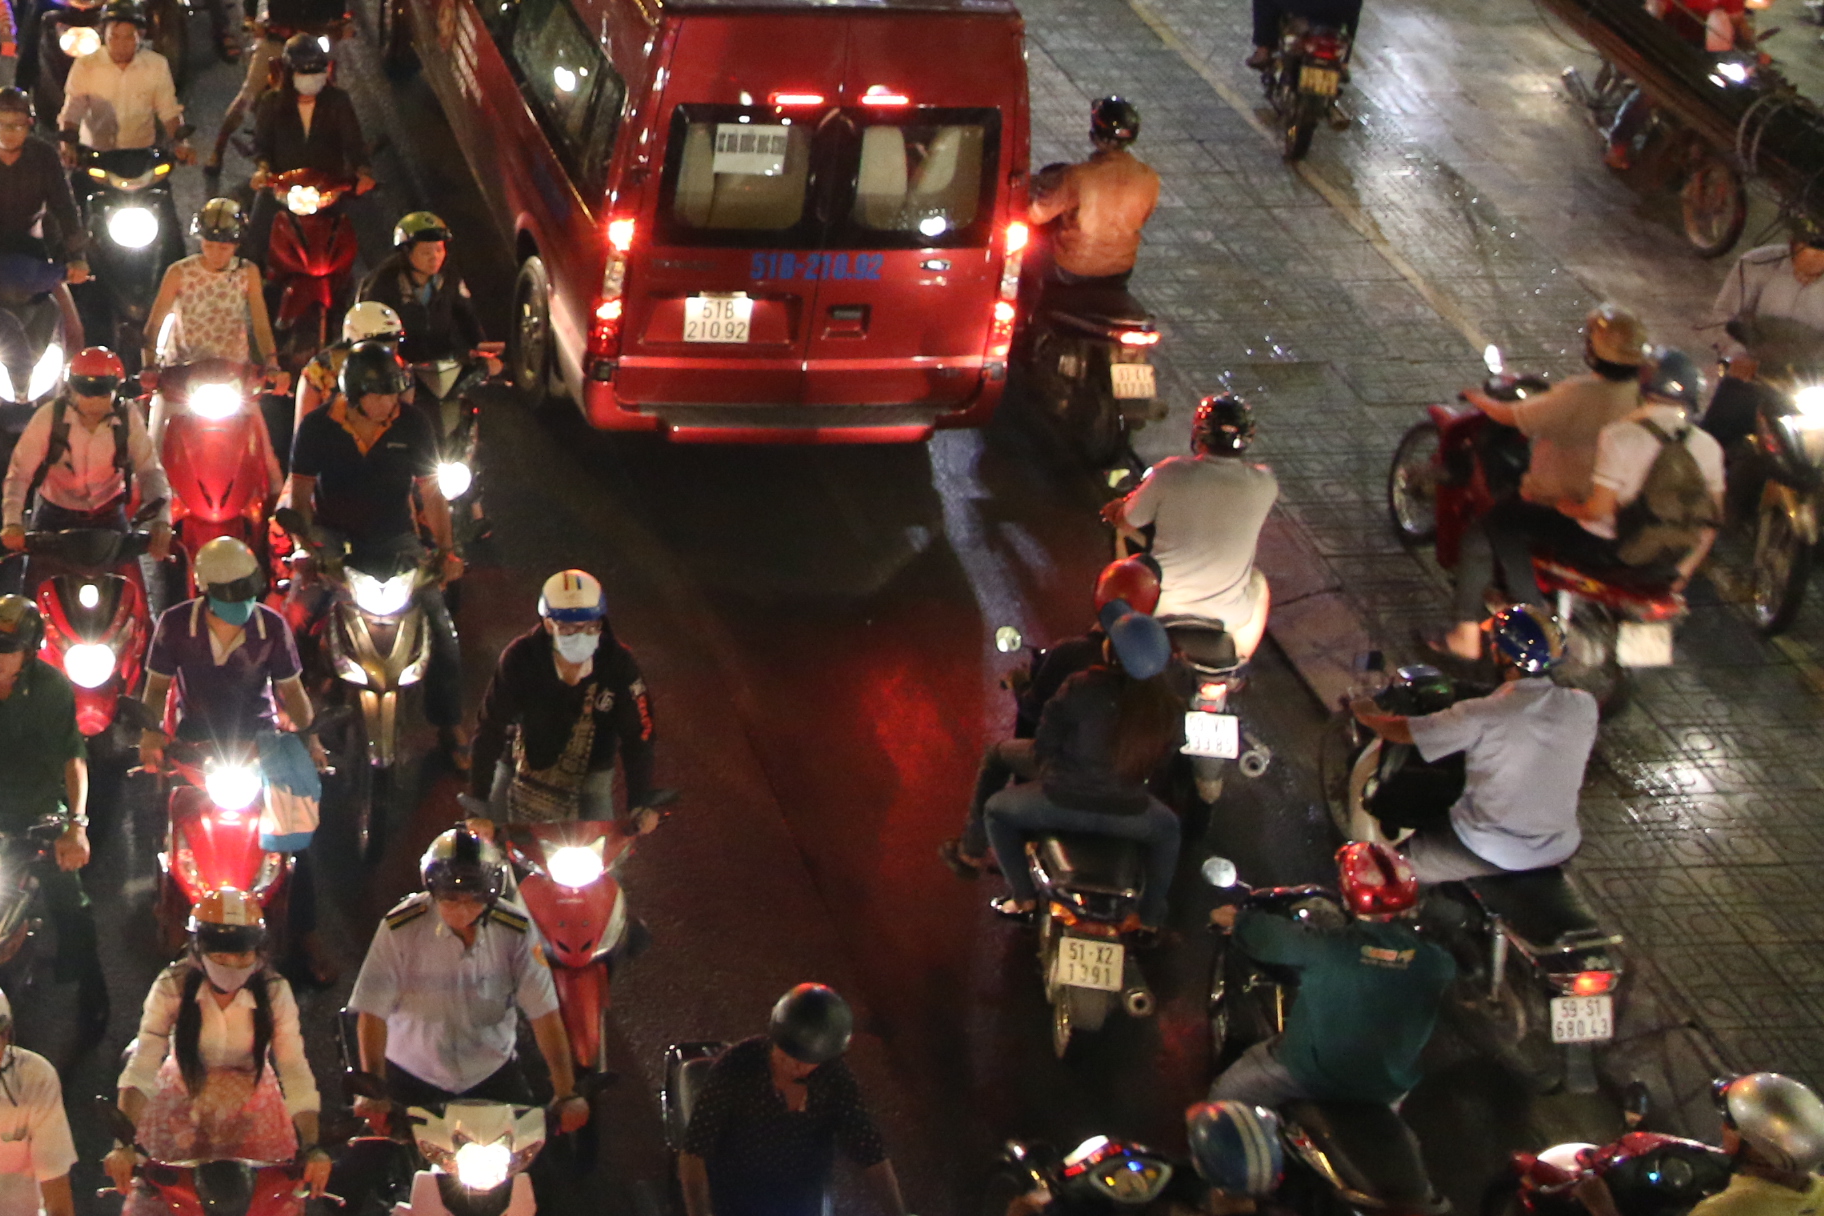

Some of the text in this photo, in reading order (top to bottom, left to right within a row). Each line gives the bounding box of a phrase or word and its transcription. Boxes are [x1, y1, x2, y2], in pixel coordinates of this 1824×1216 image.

[751, 252, 884, 281] 51B-210.92
[703, 300, 735, 320] 51B
[686, 321, 748, 340] 210.92
[1069, 942, 1114, 965] 51-X2
